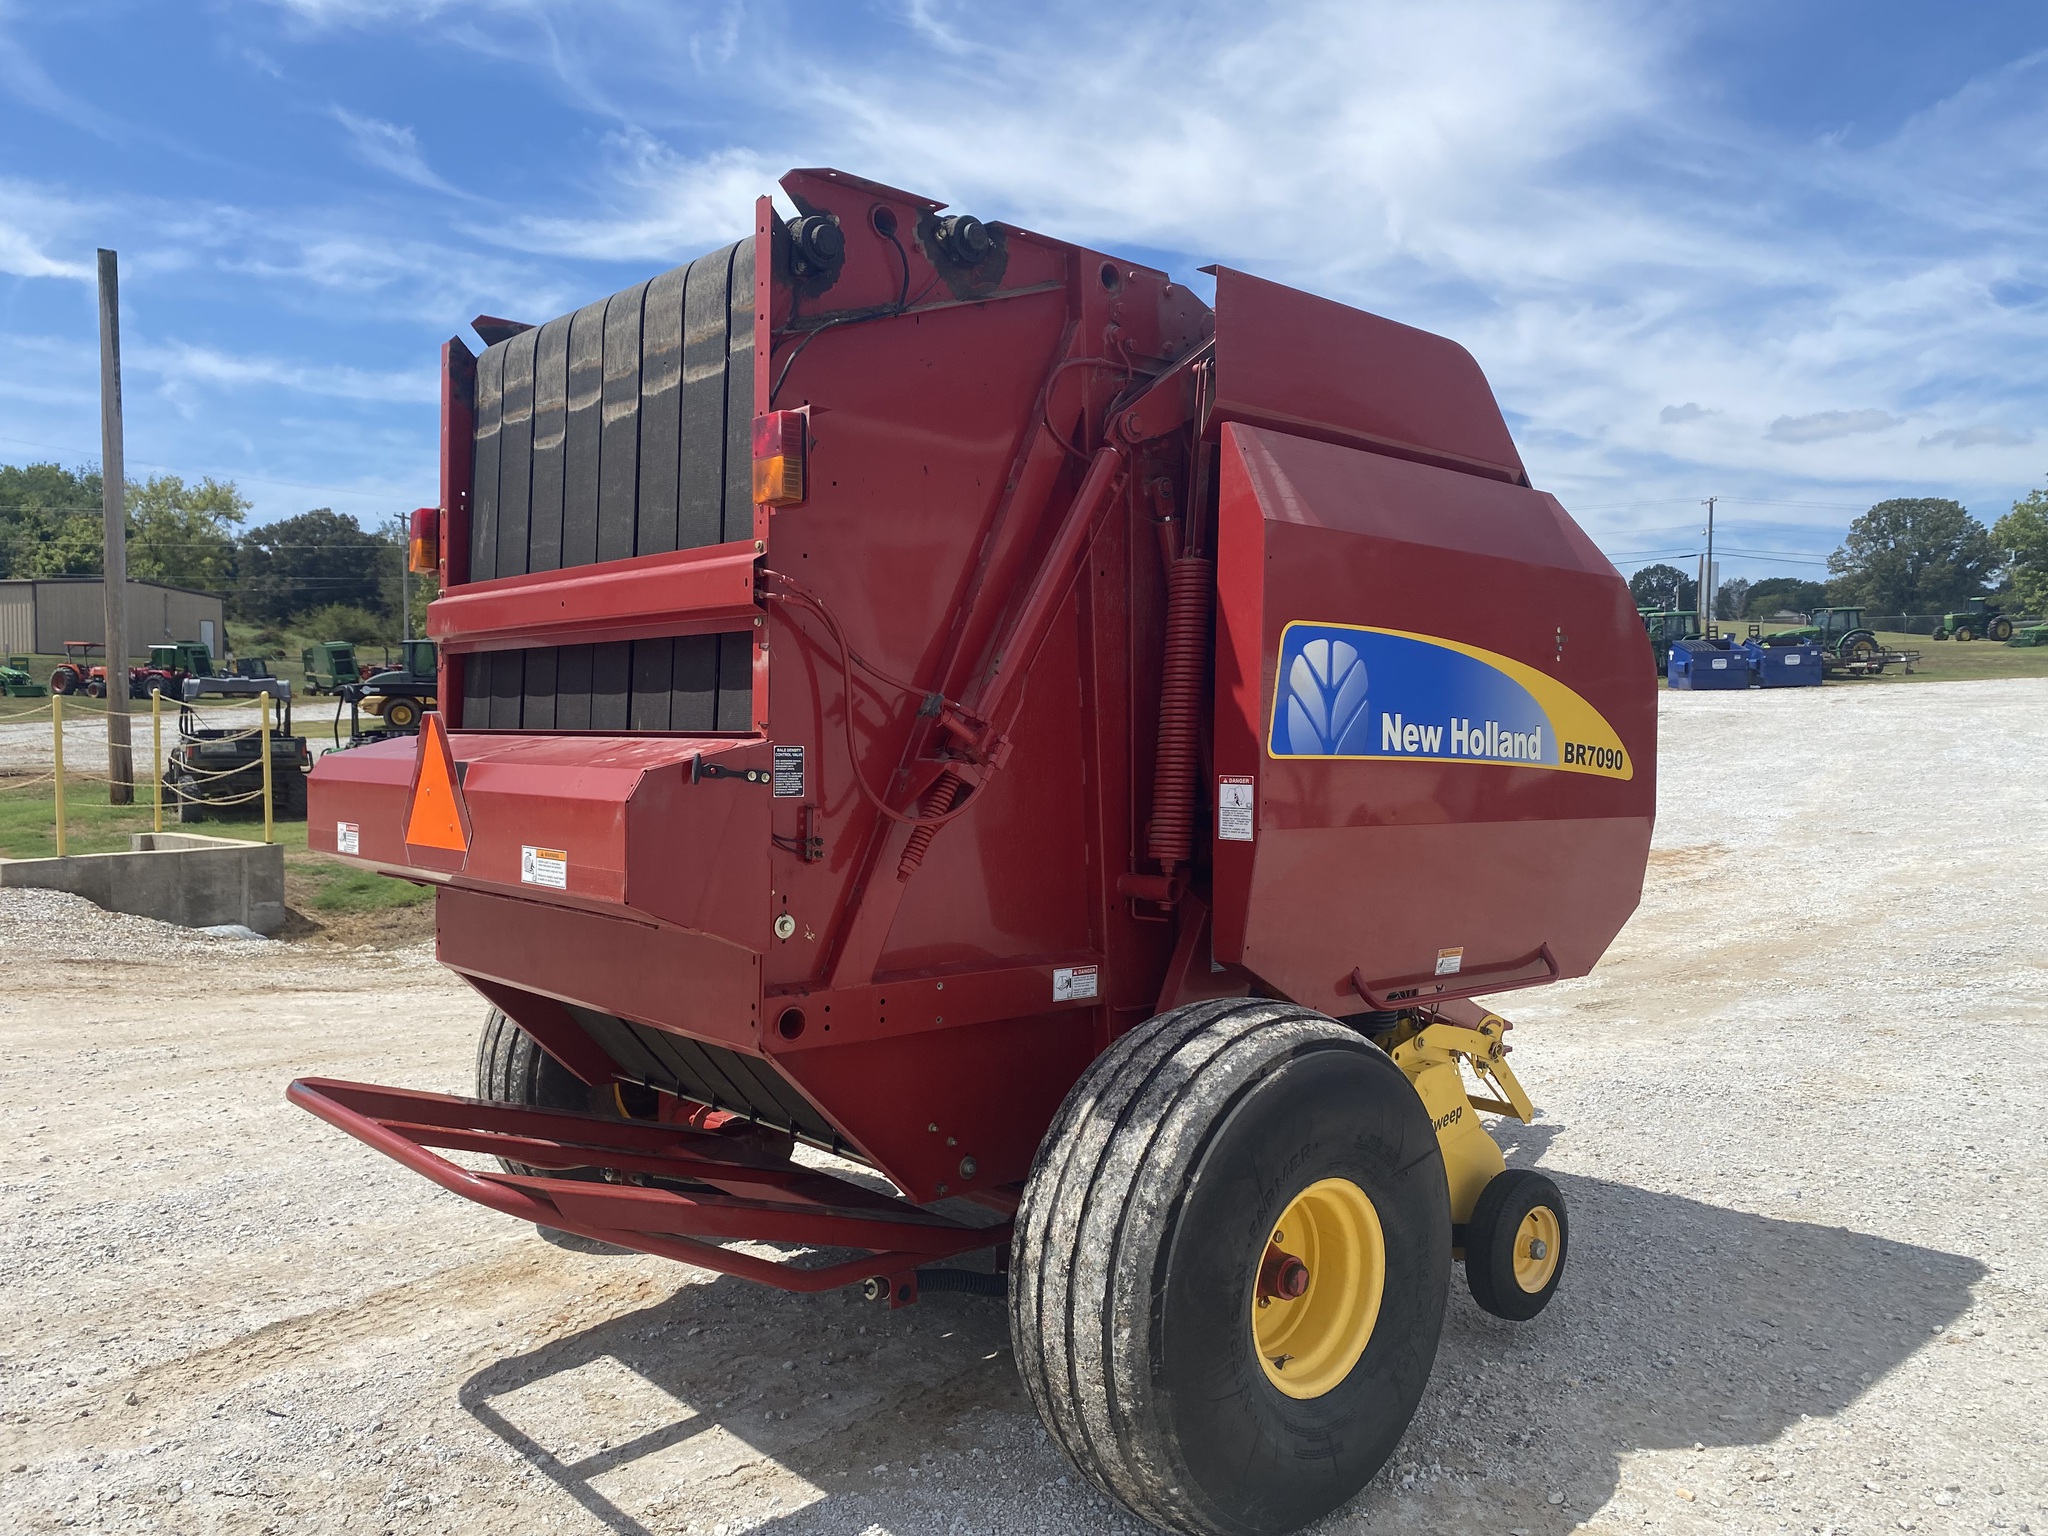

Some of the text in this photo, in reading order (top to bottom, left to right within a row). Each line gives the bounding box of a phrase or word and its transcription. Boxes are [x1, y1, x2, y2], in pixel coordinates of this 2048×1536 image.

[1381, 711, 1542, 761] New Holland
[1564, 742, 1624, 771] BR7090
[1078, 967, 1096, 975] DANGER
[1248, 1142, 1312, 1240] FARMER
